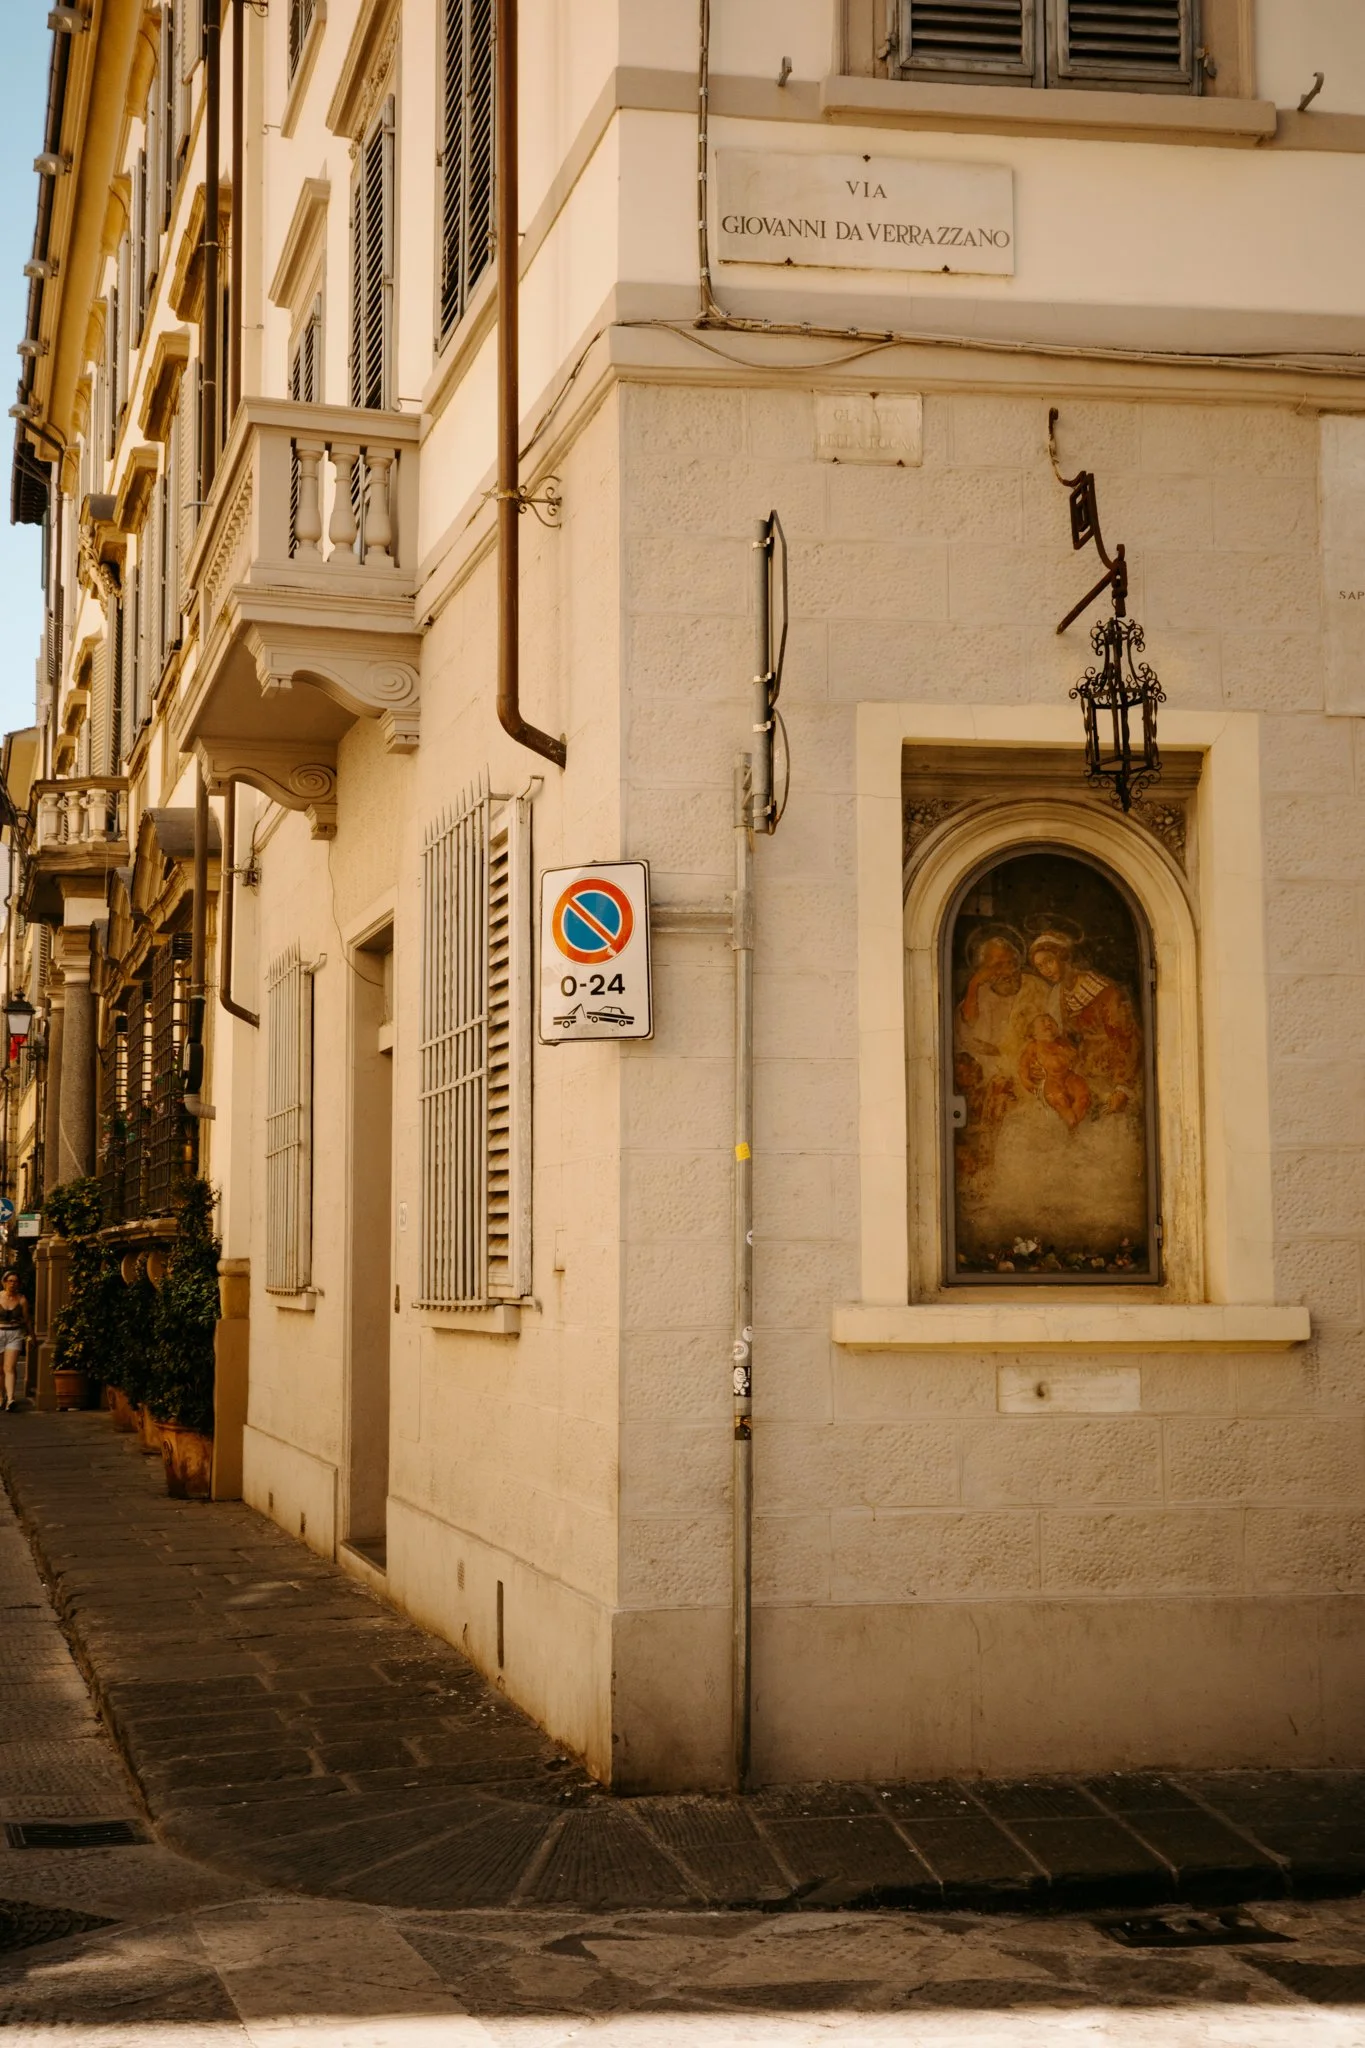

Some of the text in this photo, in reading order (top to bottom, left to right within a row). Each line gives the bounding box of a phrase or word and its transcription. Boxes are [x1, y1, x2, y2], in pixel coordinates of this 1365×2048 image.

[845, 180, 888, 199] VIA
[721, 215, 1010, 248] GIOVANNI DA VERRAZZANO
[560, 973, 626, 997] 0-24
